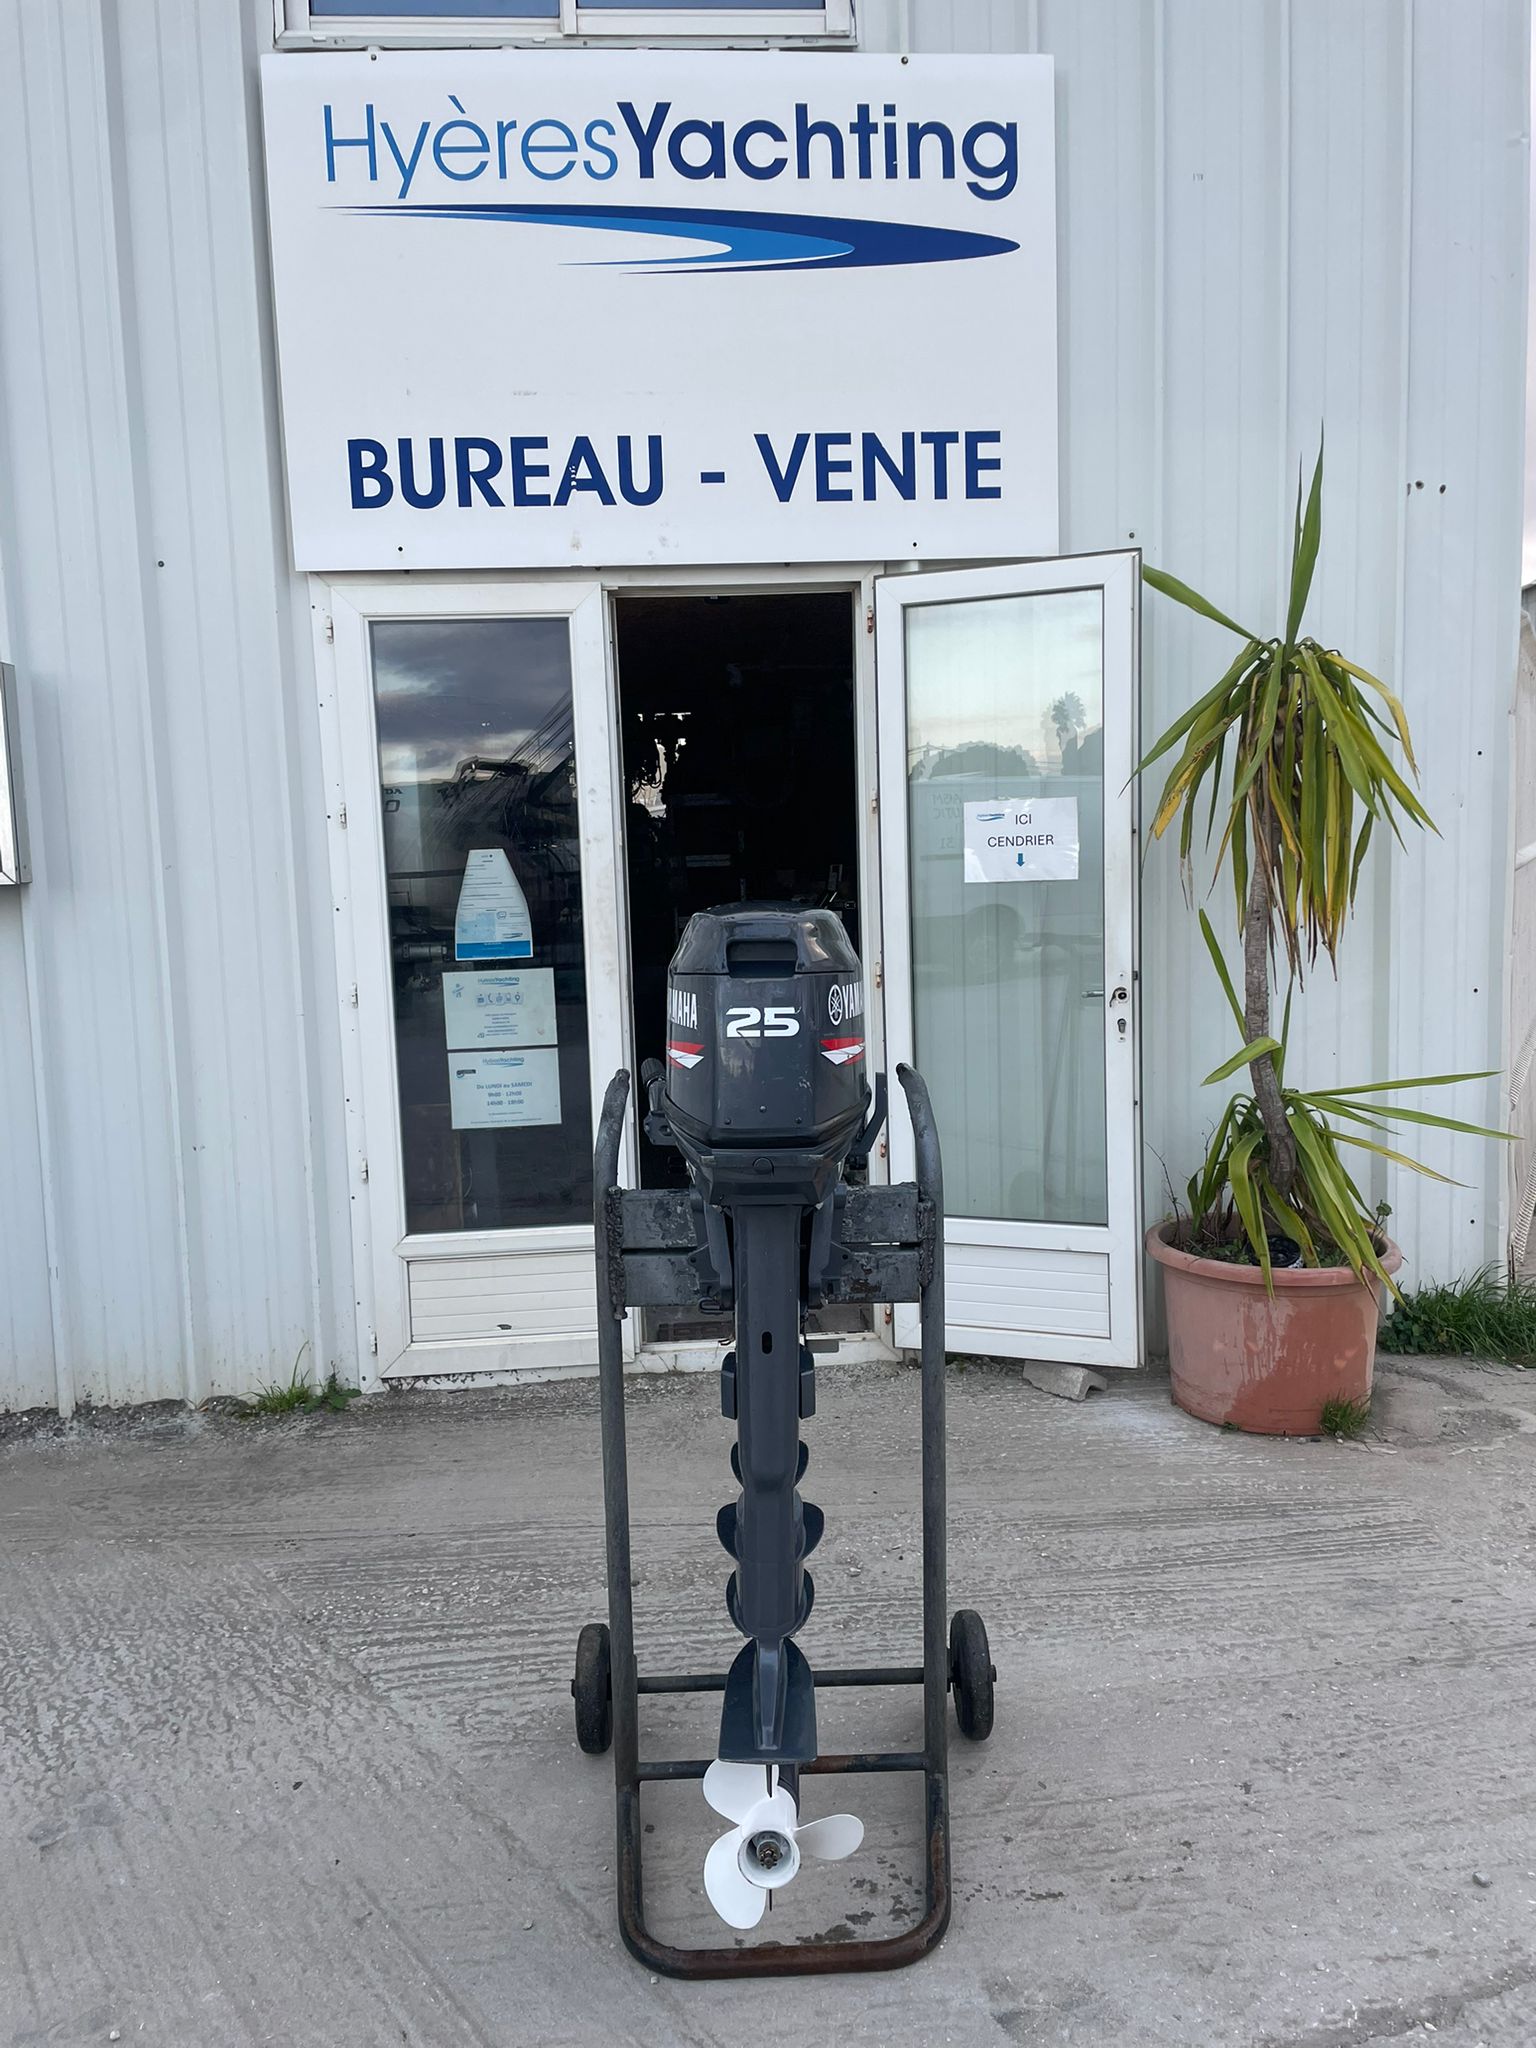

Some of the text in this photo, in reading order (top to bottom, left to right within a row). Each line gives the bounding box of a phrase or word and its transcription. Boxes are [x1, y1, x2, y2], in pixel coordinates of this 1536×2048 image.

[323, 95, 1019, 201] HyèresYachting
[347, 430, 1002, 509] BUREAU - VENTE
[1015, 813, 1033, 825] ICI
[987, 834, 1054, 848] CENDRIER
[725, 1006, 801, 1038] 25
